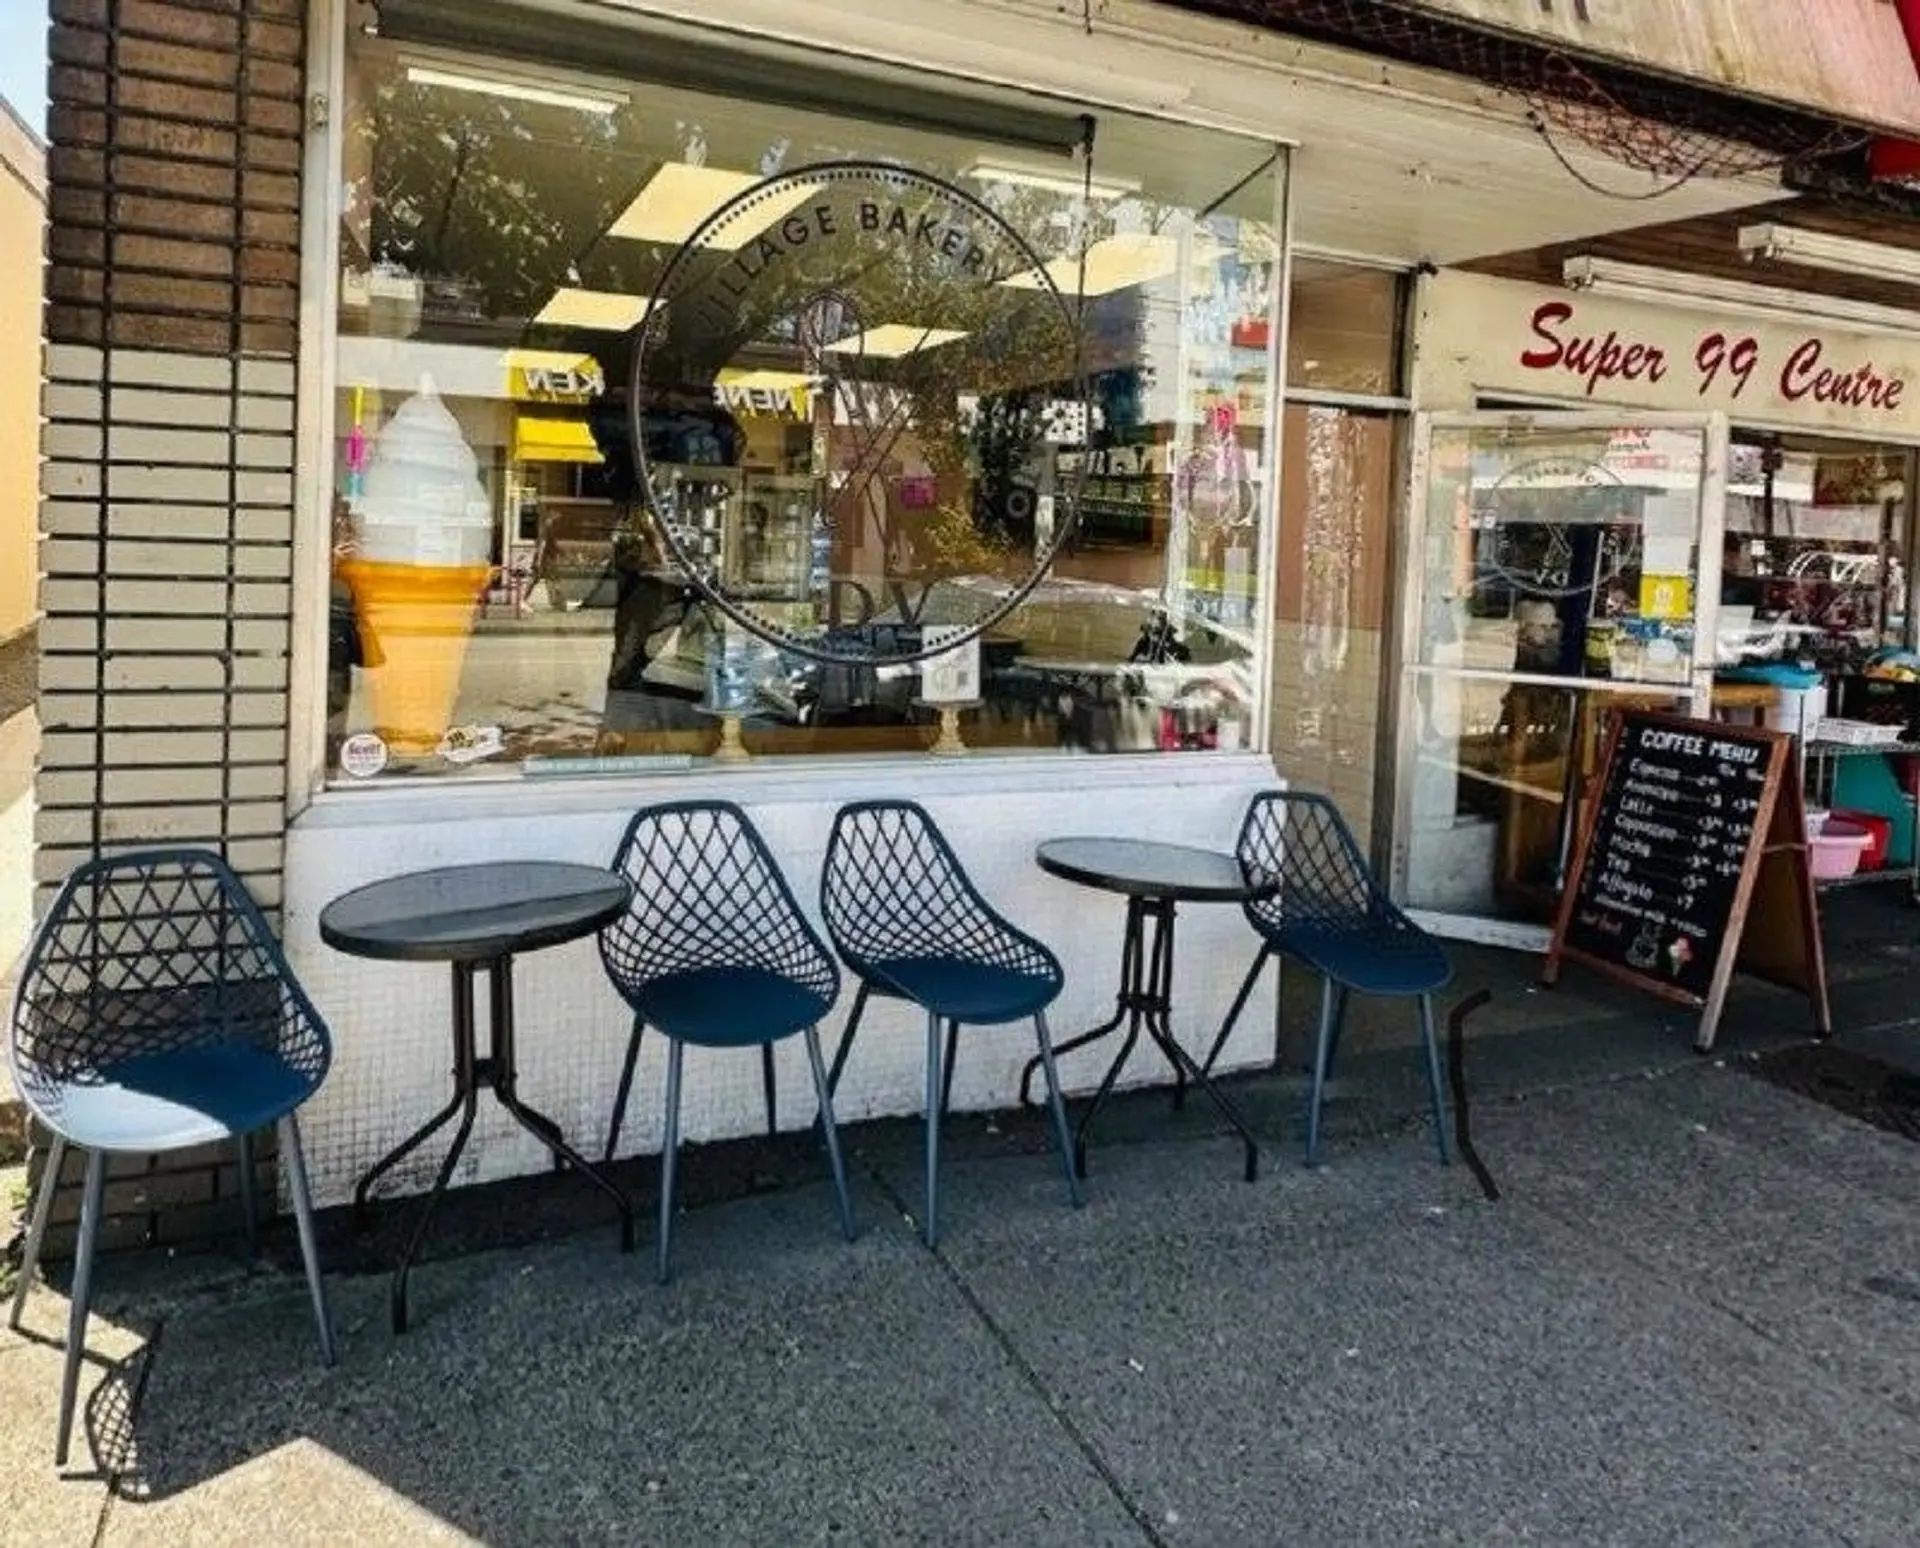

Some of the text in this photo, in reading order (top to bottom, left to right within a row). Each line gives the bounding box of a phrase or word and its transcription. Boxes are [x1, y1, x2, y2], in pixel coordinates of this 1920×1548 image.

[860, 202, 1007, 289] BAKERY
[1520, 302, 1904, 410] Super 99 Centre
[1640, 729, 1759, 763] COFFEE MENU
